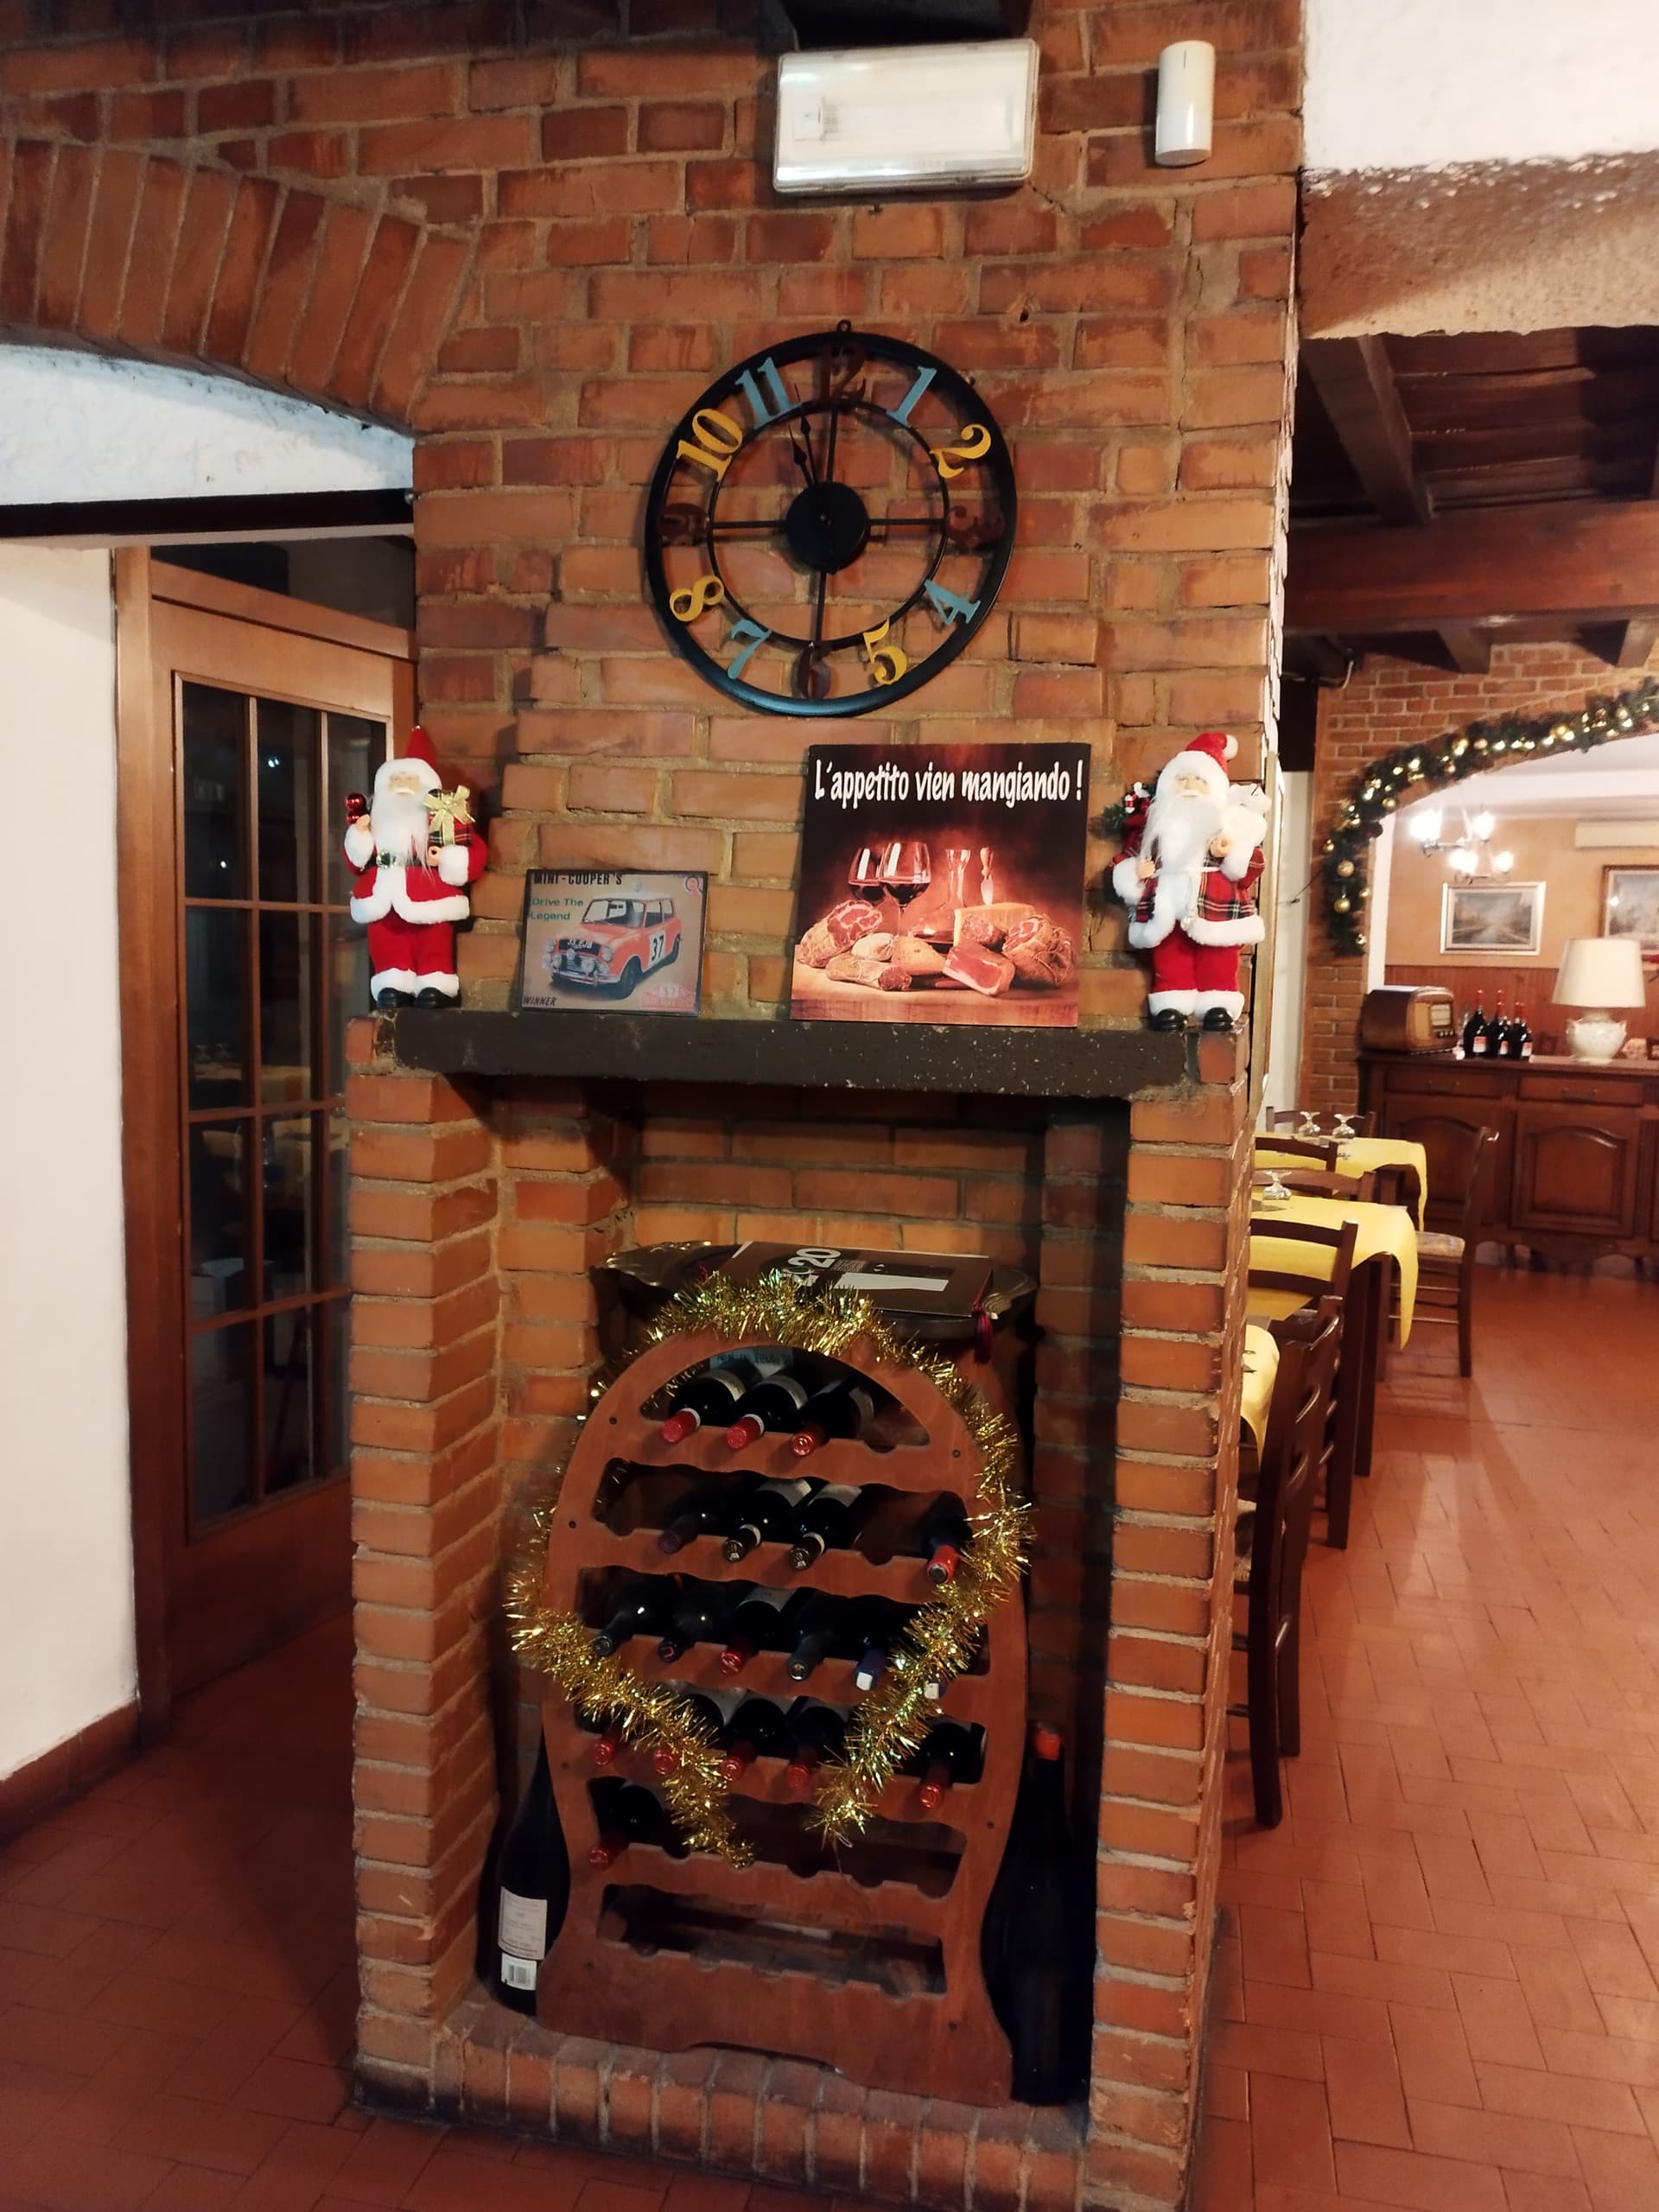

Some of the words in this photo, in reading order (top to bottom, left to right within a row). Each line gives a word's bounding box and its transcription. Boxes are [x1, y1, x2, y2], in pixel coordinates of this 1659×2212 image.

[735, 357, 802, 429] 11
[819, 344, 866, 402] 12
[887, 366, 938, 428] 1
[676, 409, 743, 481] 10
[929, 423, 991, 479] 2
[658, 502, 708, 540] 9
[946, 505, 1005, 547] 3
[669, 575, 724, 622] 8
[924, 579, 982, 626] 4
[727, 619, 772, 680] 7
[791, 645, 832, 700] 6
[862, 619, 908, 685] 5
[814, 759, 910, 810] L'appetito
[915, 761, 955, 802] vien
[531, 898, 561, 906] Drive
[531, 912, 570, 922] Legend
[652, 935, 664, 961] 37
[523, 995, 557, 1007] WINNER
